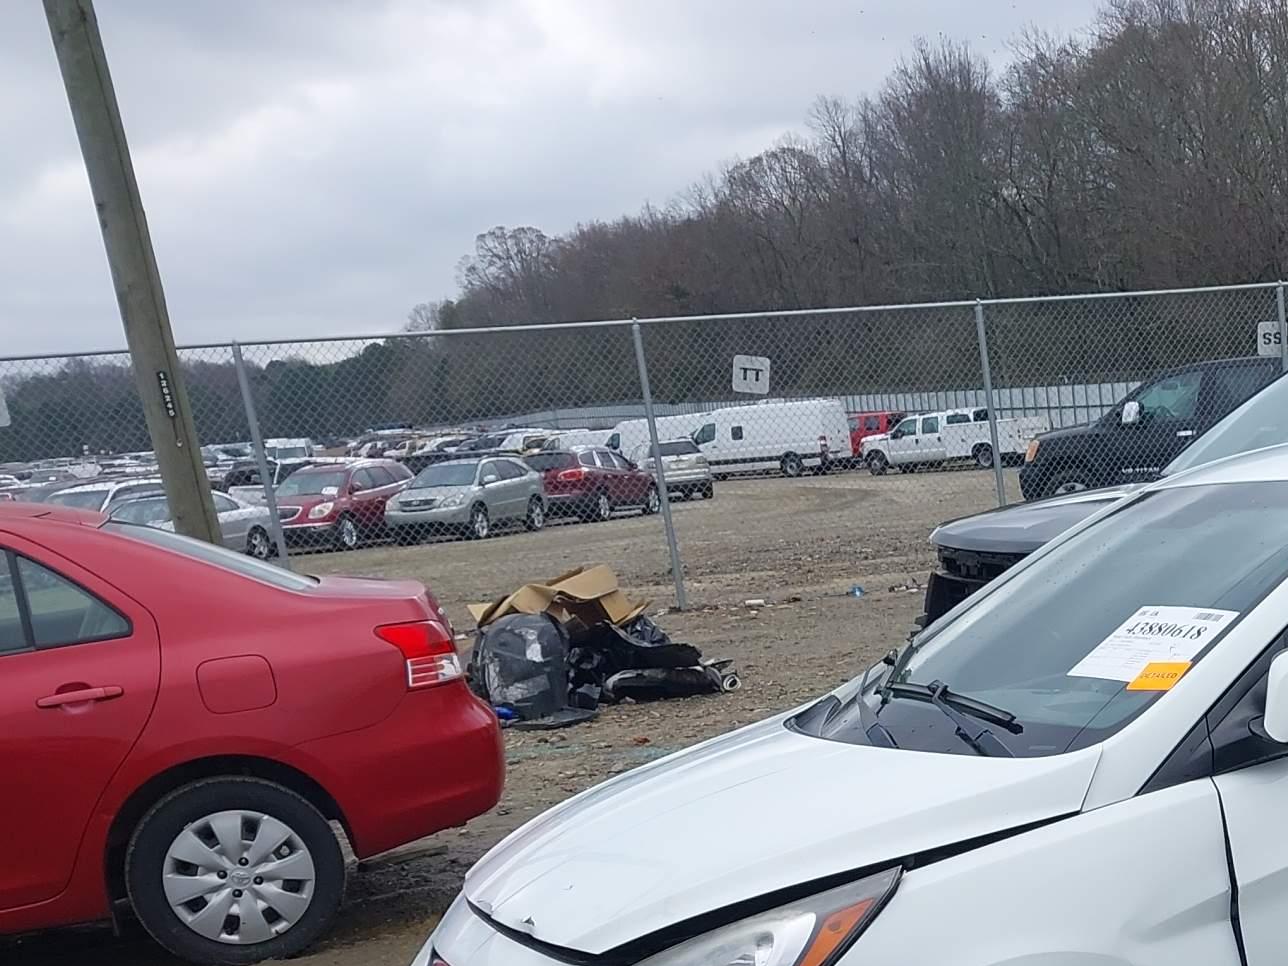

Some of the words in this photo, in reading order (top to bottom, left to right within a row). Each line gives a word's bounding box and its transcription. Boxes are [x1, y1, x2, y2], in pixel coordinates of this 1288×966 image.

[1262, 331, 1282, 345] SS
[739, 367, 764, 382] TT
[1126, 622, 1207, 640] 43880618
